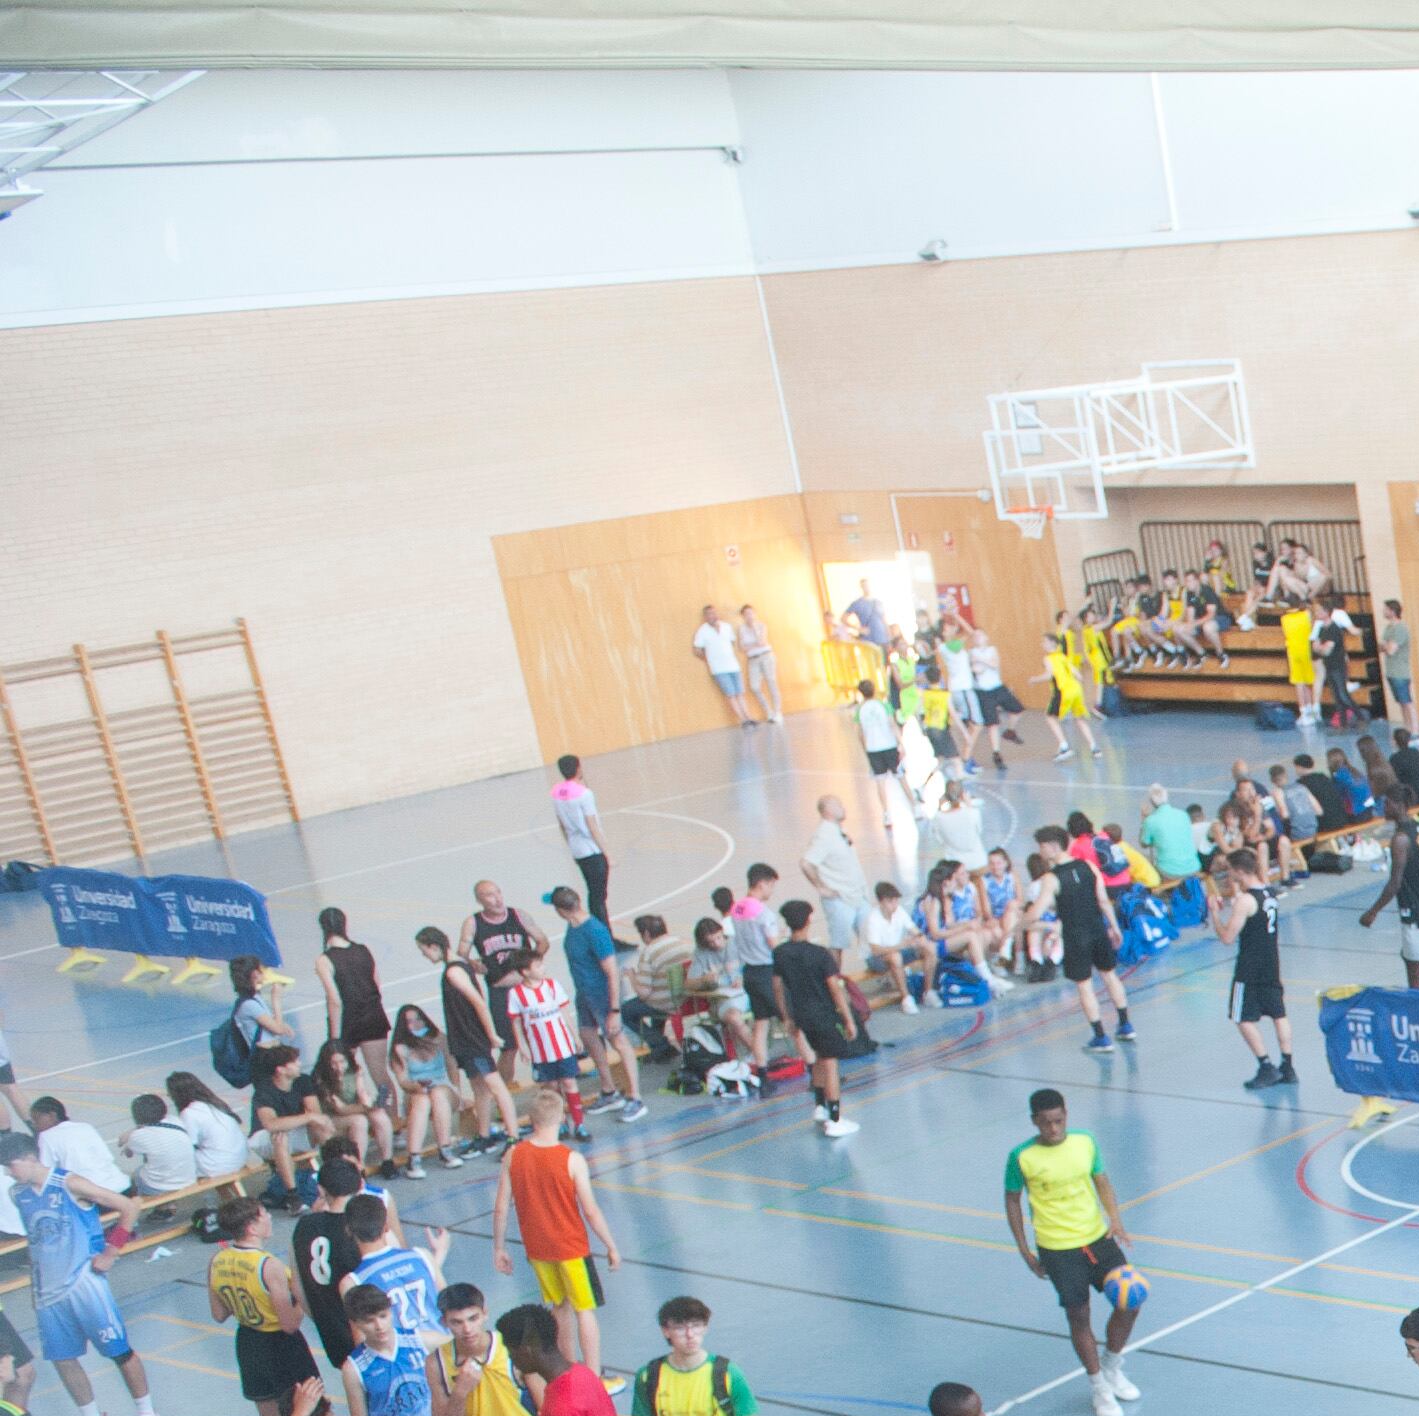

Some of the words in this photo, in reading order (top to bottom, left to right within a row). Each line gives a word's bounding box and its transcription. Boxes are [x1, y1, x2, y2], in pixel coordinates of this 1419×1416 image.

[71, 885, 137, 910] Universidad
[185, 895, 255, 921] Universidad
[192, 915, 237, 935] Zaragoza
[310, 1235, 332, 1286] 8
[219, 1285, 264, 1327] 10
[386, 1278, 428, 1329] 27
